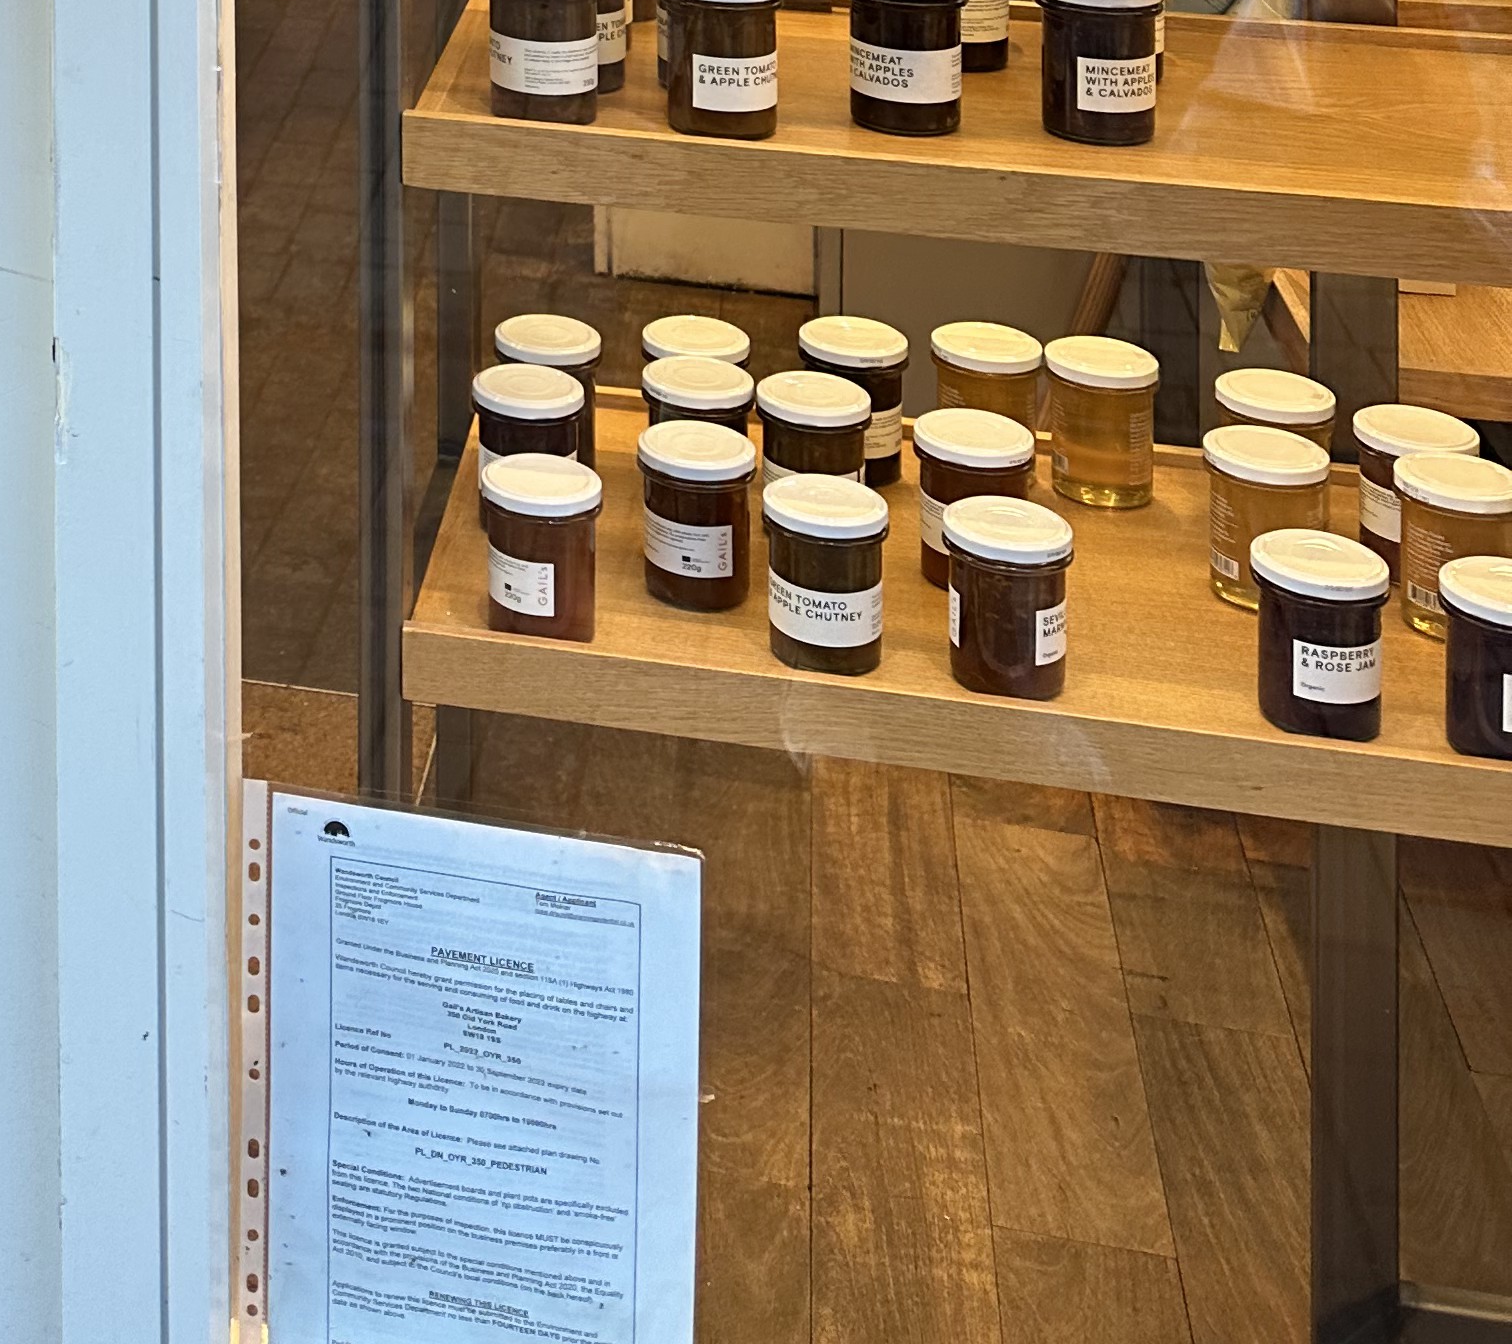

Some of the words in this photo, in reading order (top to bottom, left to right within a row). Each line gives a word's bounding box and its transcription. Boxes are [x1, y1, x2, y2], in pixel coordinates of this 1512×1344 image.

[698, 63, 740, 76] GREEN
[868, 63, 914, 78] APPLES
[1085, 64, 1150, 76] MINCEMEAT
[698, 75, 705, 84] &
[710, 77, 750, 87] APPLE
[854, 68, 909, 88] CALVADOS
[1085, 76, 1118, 86] WITH
[1123, 72, 1154, 87] APPLES
[1085, 87, 1093, 96] &
[1098, 85, 1153, 98] CALVADOS
[718, 531, 728, 571] GAIL's
[681, 562, 701, 573] 220g
[538, 566, 548, 606] GAIL's
[504, 591, 521, 603] 220g
[795, 594, 847, 611] TOMATO
[773, 592, 801, 615] APPLE
[806, 610, 863, 622] CHUTNEY
[1301, 646, 1374, 661] RASPBERRY
[1301, 658, 1309, 667] &
[1315, 661, 1352, 672] ROSE
[1356, 658, 1376, 672] JAM
[1300, 681, 1325, 692] Organic
[334, 867, 374, 878] Wandsworth
[374, 874, 399, 882] Council
[395, 950, 425, 961] Business
[440, 958, 469, 970] Planning
[430, 946, 487, 963] PAVEMENT
[489, 956, 535, 972] LICENCE
[335, 954, 379, 967] Wandsworth
[379, 962, 407, 974] Council
[407, 969, 433, 980] hereby
[433, 975, 453, 983] grant
[453, 979, 493, 990] permission
[505, 987, 518, 995] the
[518, 990, 545, 1001] placing
[619, 1006, 634, 1014] and
[442, 1001, 465, 1011] Gail's
[465, 1006, 494, 1016] Artisan
[494, 1011, 522, 1023] Bakery
[461, 1013, 476, 1021] Old
[477, 1016, 495, 1025] York
[497, 1020, 518, 1030] Road
[467, 1024, 497, 1033] London
[414, 1147, 547, 1174] PL_DN_OYR_350_PEDESTRIAN
[537, 1329, 561, 1339] DAYS
